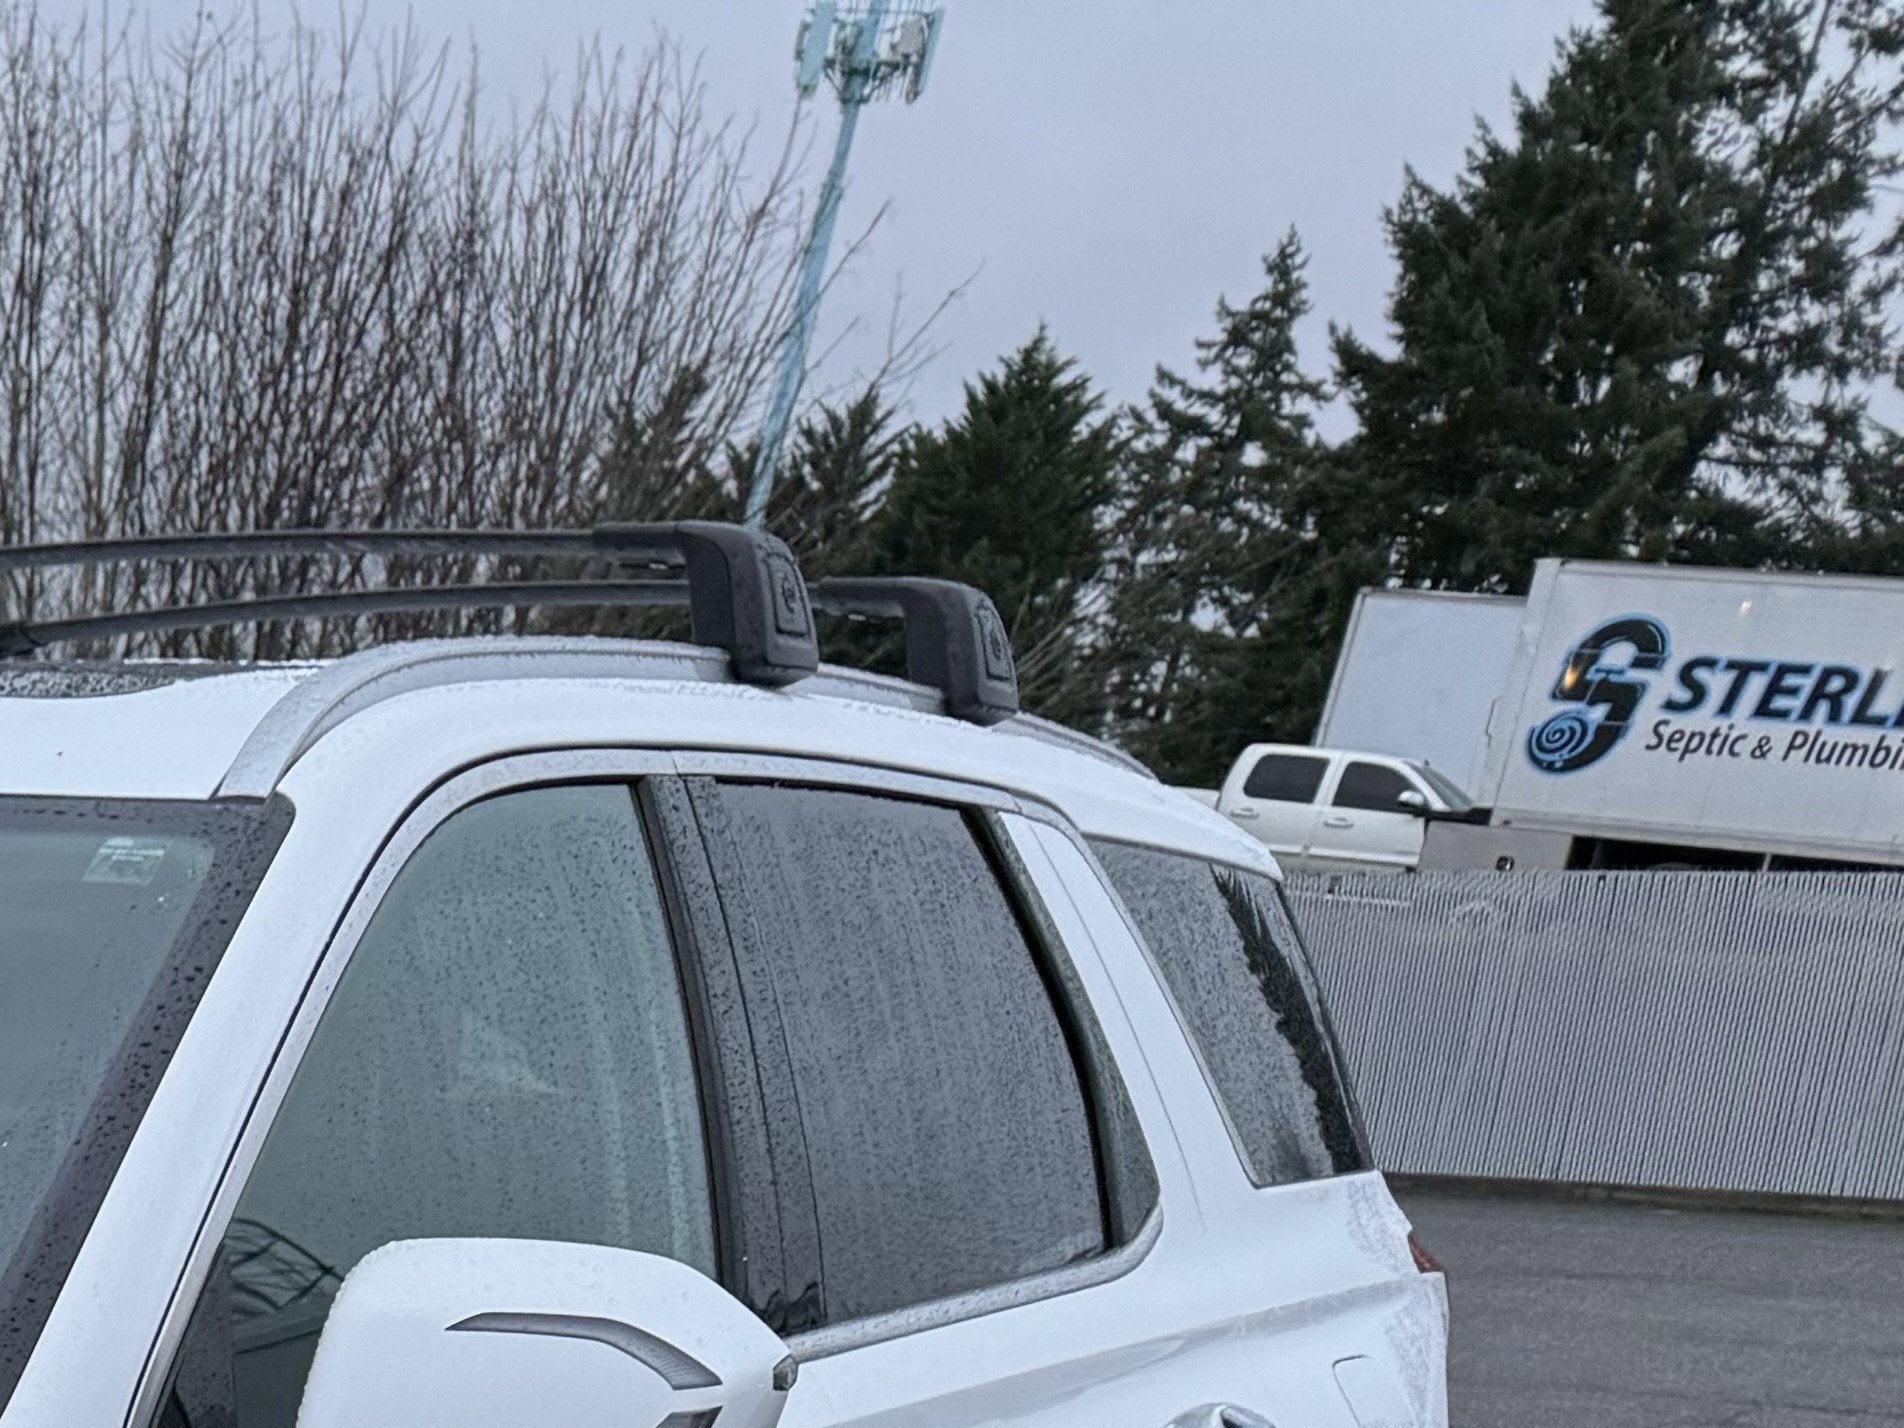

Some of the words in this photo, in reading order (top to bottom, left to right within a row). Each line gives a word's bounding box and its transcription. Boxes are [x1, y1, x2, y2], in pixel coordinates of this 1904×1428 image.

[1661, 657, 1904, 727] STERL
[1645, 719, 1747, 762] Septic
[1750, 735, 1772, 760] &
[1782, 729, 1904, 772] Plumbi
